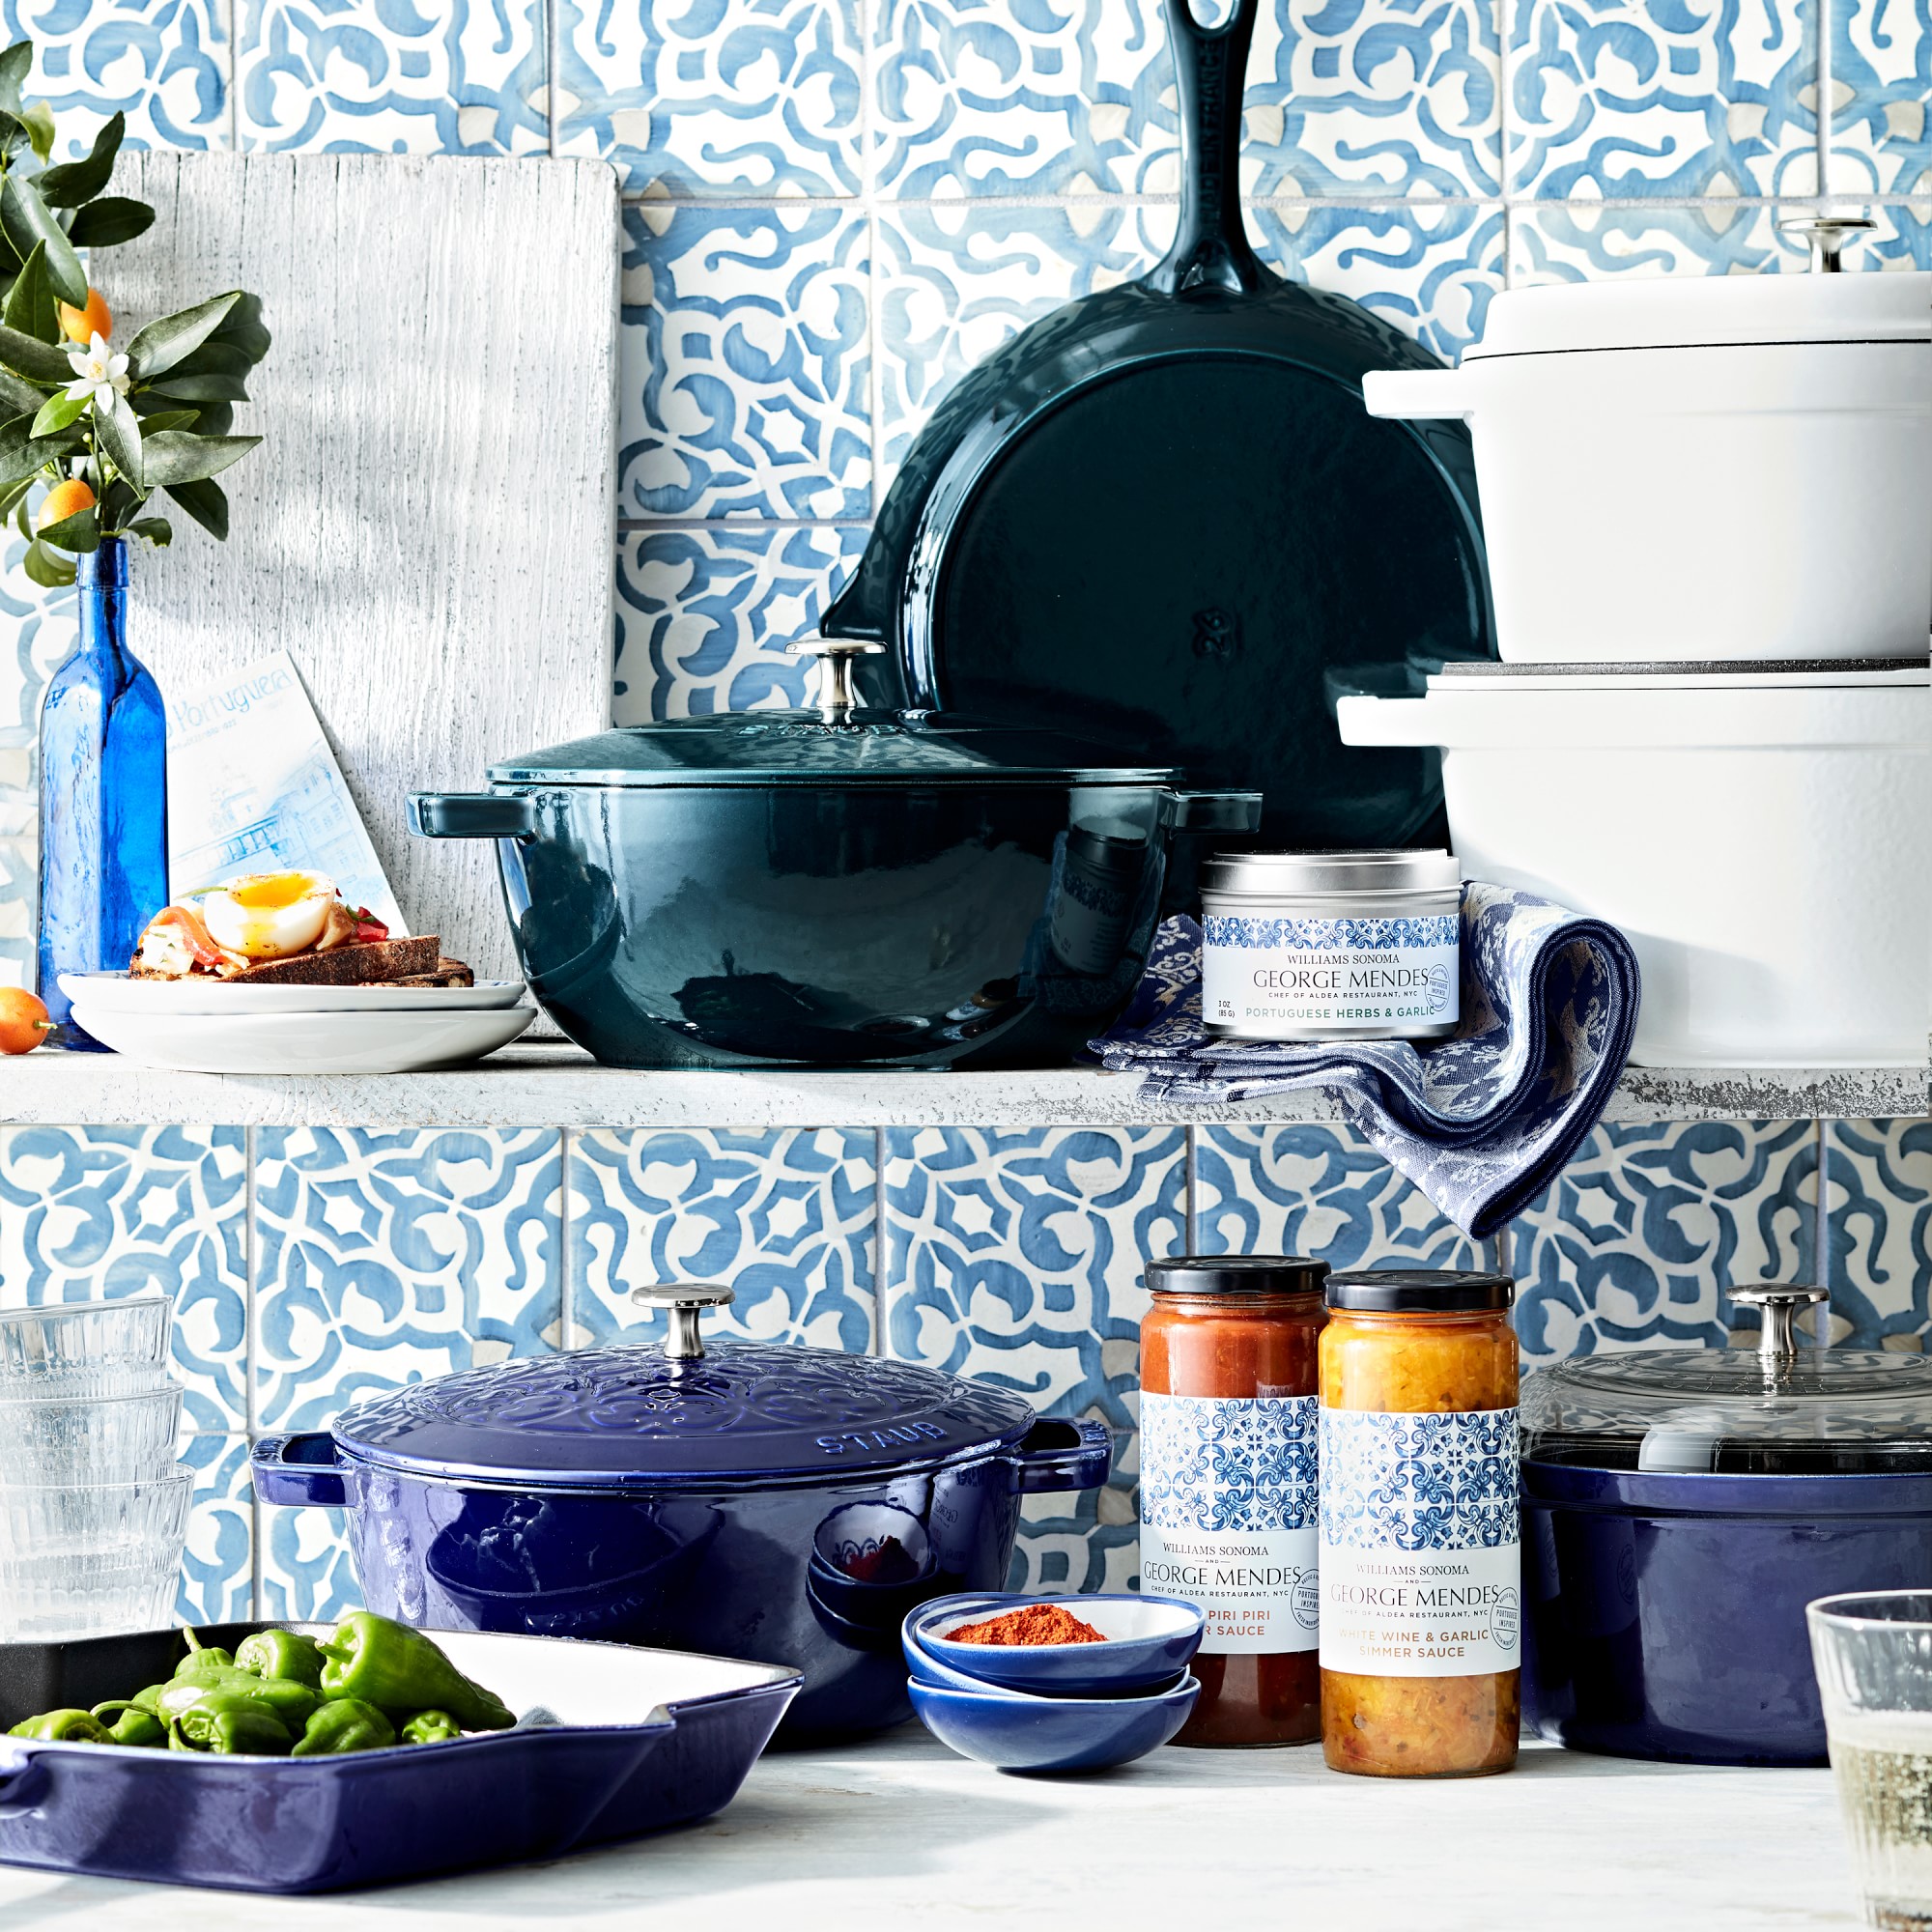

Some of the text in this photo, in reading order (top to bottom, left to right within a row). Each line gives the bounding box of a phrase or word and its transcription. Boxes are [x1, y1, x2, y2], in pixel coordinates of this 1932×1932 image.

[1287, 953, 1400, 965] WILLIAMS SONOMA
[1253, 969, 1341, 988] GEORGE
[1349, 968, 1429, 988] MENDES
[1245, 1006, 1435, 1019] PORTUGUESE HERBS & GARLIC
[814, 1421, 950, 1454] STAUB
[1162, 1542, 1269, 1556] WILLIAMS SONOMA
[1144, 1561, 1301, 1586] GEORGE MENDES
[1356, 1563, 1470, 1576] WILLIAMS SONOMA
[1151, 1585, 1165, 1594] CHEF
[1331, 1583, 1407, 1606] GEORGE
[1415, 1584, 1498, 1606] MENDES
[1300, 1600, 1320, 1609] INSPIRE
[1208, 1610, 1270, 1621] PIRI PIRI
[1216, 1626, 1265, 1635] SAUCE
[1339, 1628, 1489, 1642] WHITE WINE & GARLIC
[1359, 1646, 1464, 1658] SIMMER SAUCE
